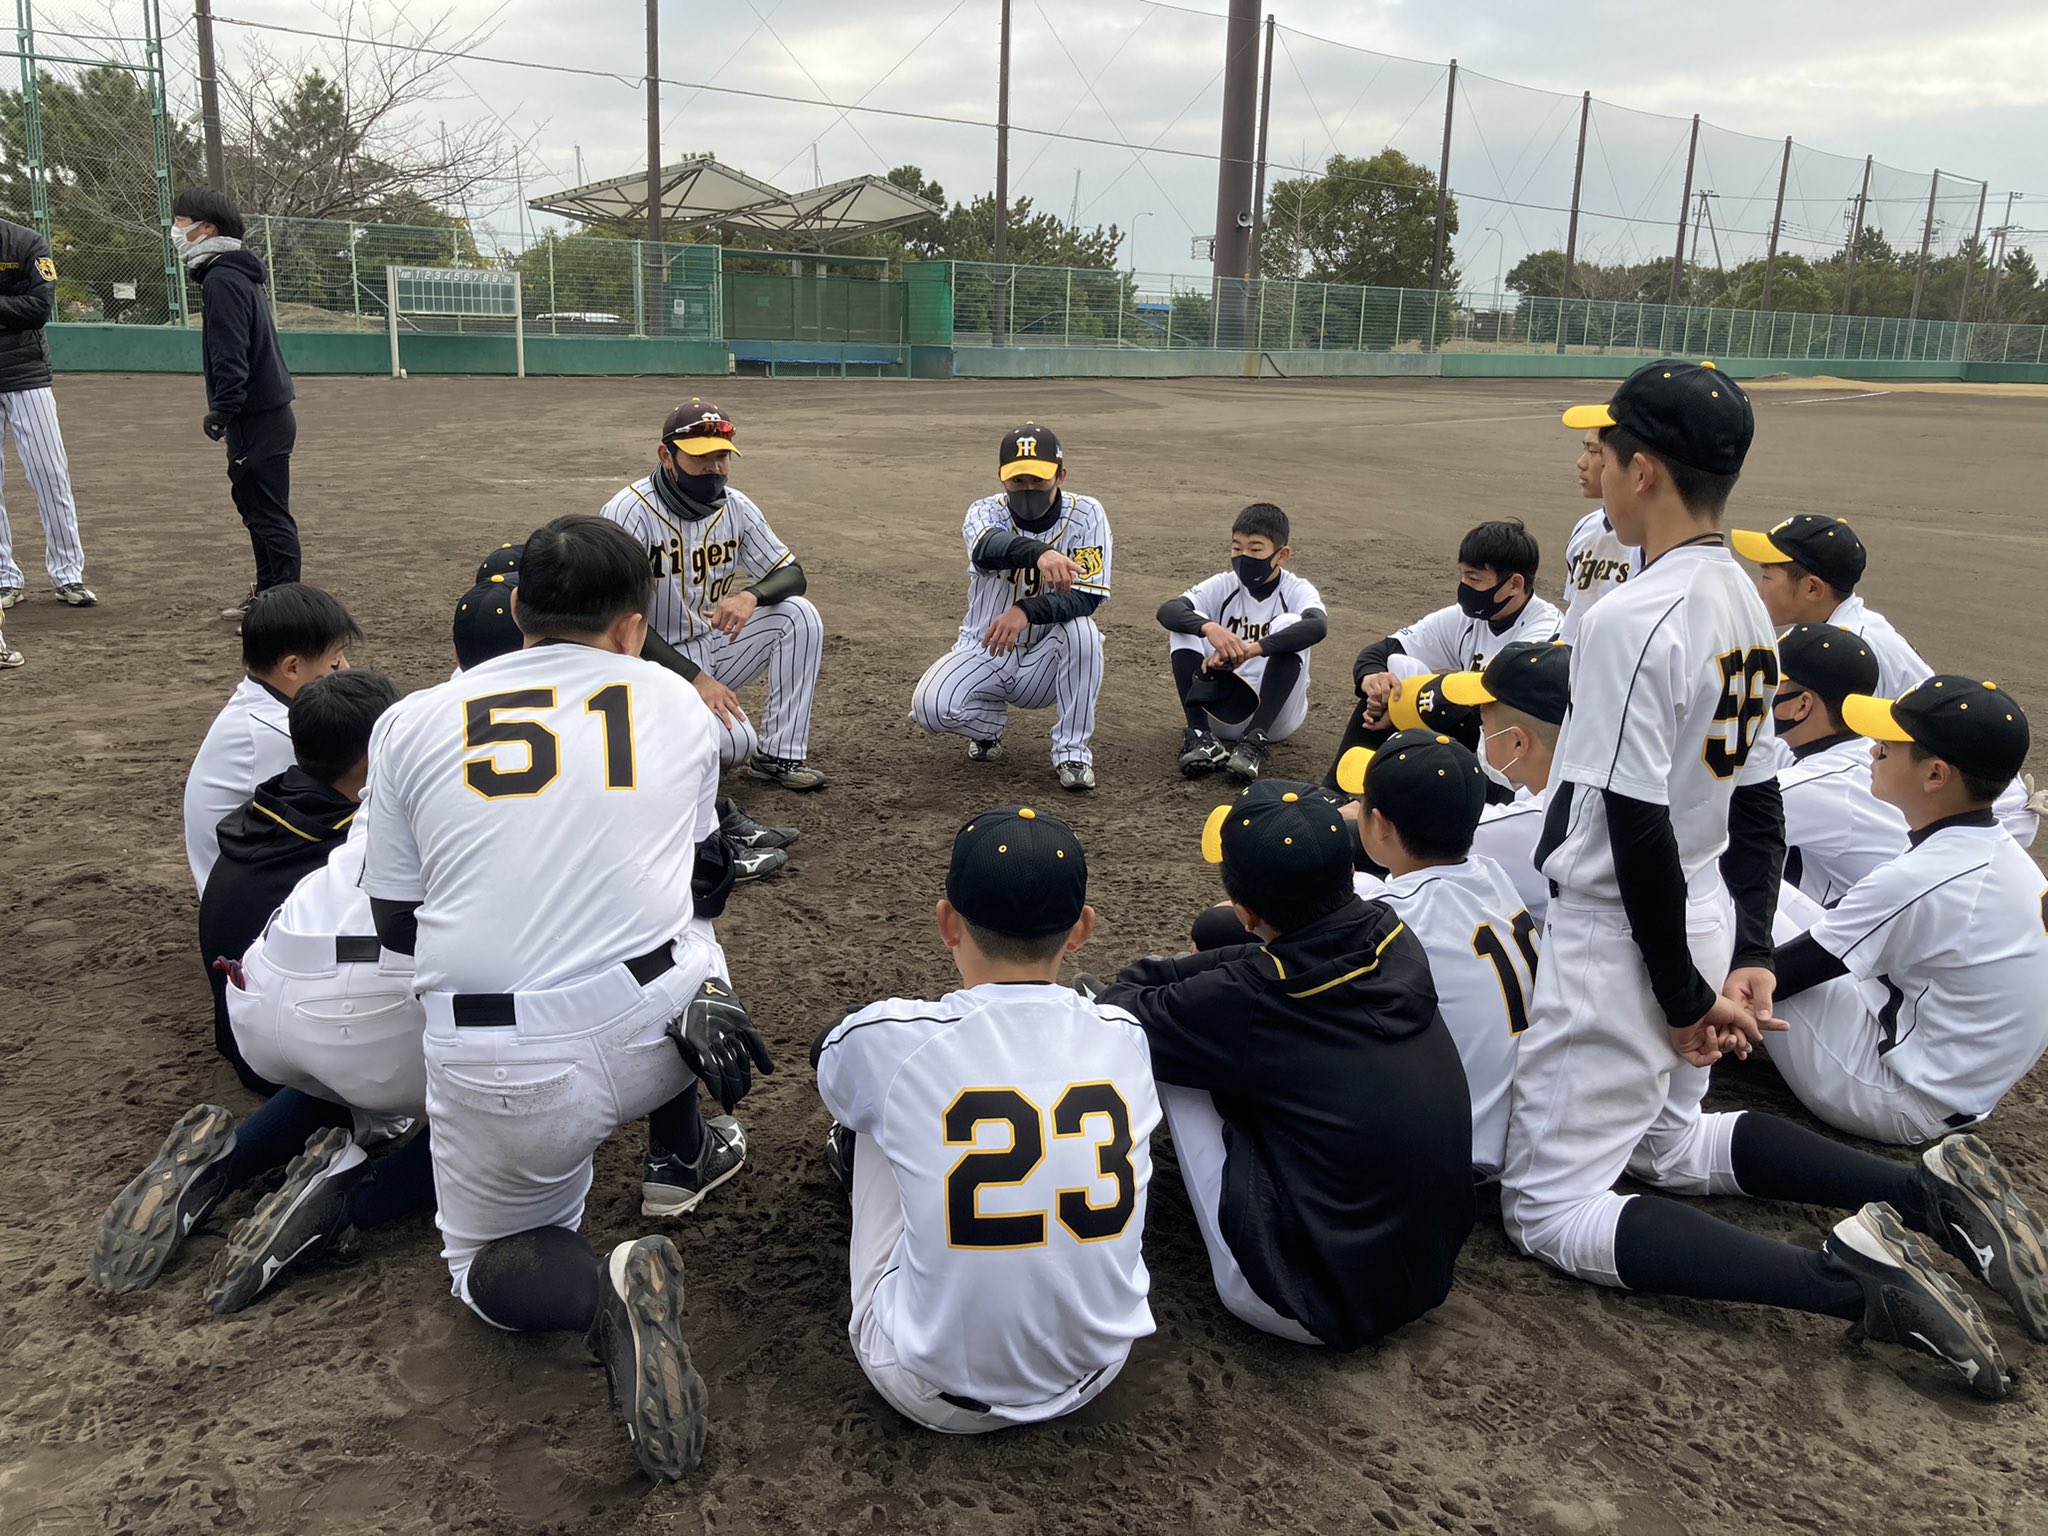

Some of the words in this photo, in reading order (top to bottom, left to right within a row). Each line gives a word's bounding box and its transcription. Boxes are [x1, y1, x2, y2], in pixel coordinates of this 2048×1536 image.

[415, 271, 420, 279] 1
[424, 271, 431, 280] 2
[434, 271, 441, 280] 3
[444, 272, 450, 280] 4
[453, 272, 461, 281] 5
[463, 272, 470, 281] 6
[472, 273, 479, 281] 7
[482, 273, 489, 282] 8
[491, 273, 498, 283] 9
[650, 537, 744, 585] Tiger
[1570, 549, 1630, 590] Tigers
[462, 682, 637, 801] 51
[1701, 645, 1779, 780] 56
[941, 1079, 1137, 1251] 23
